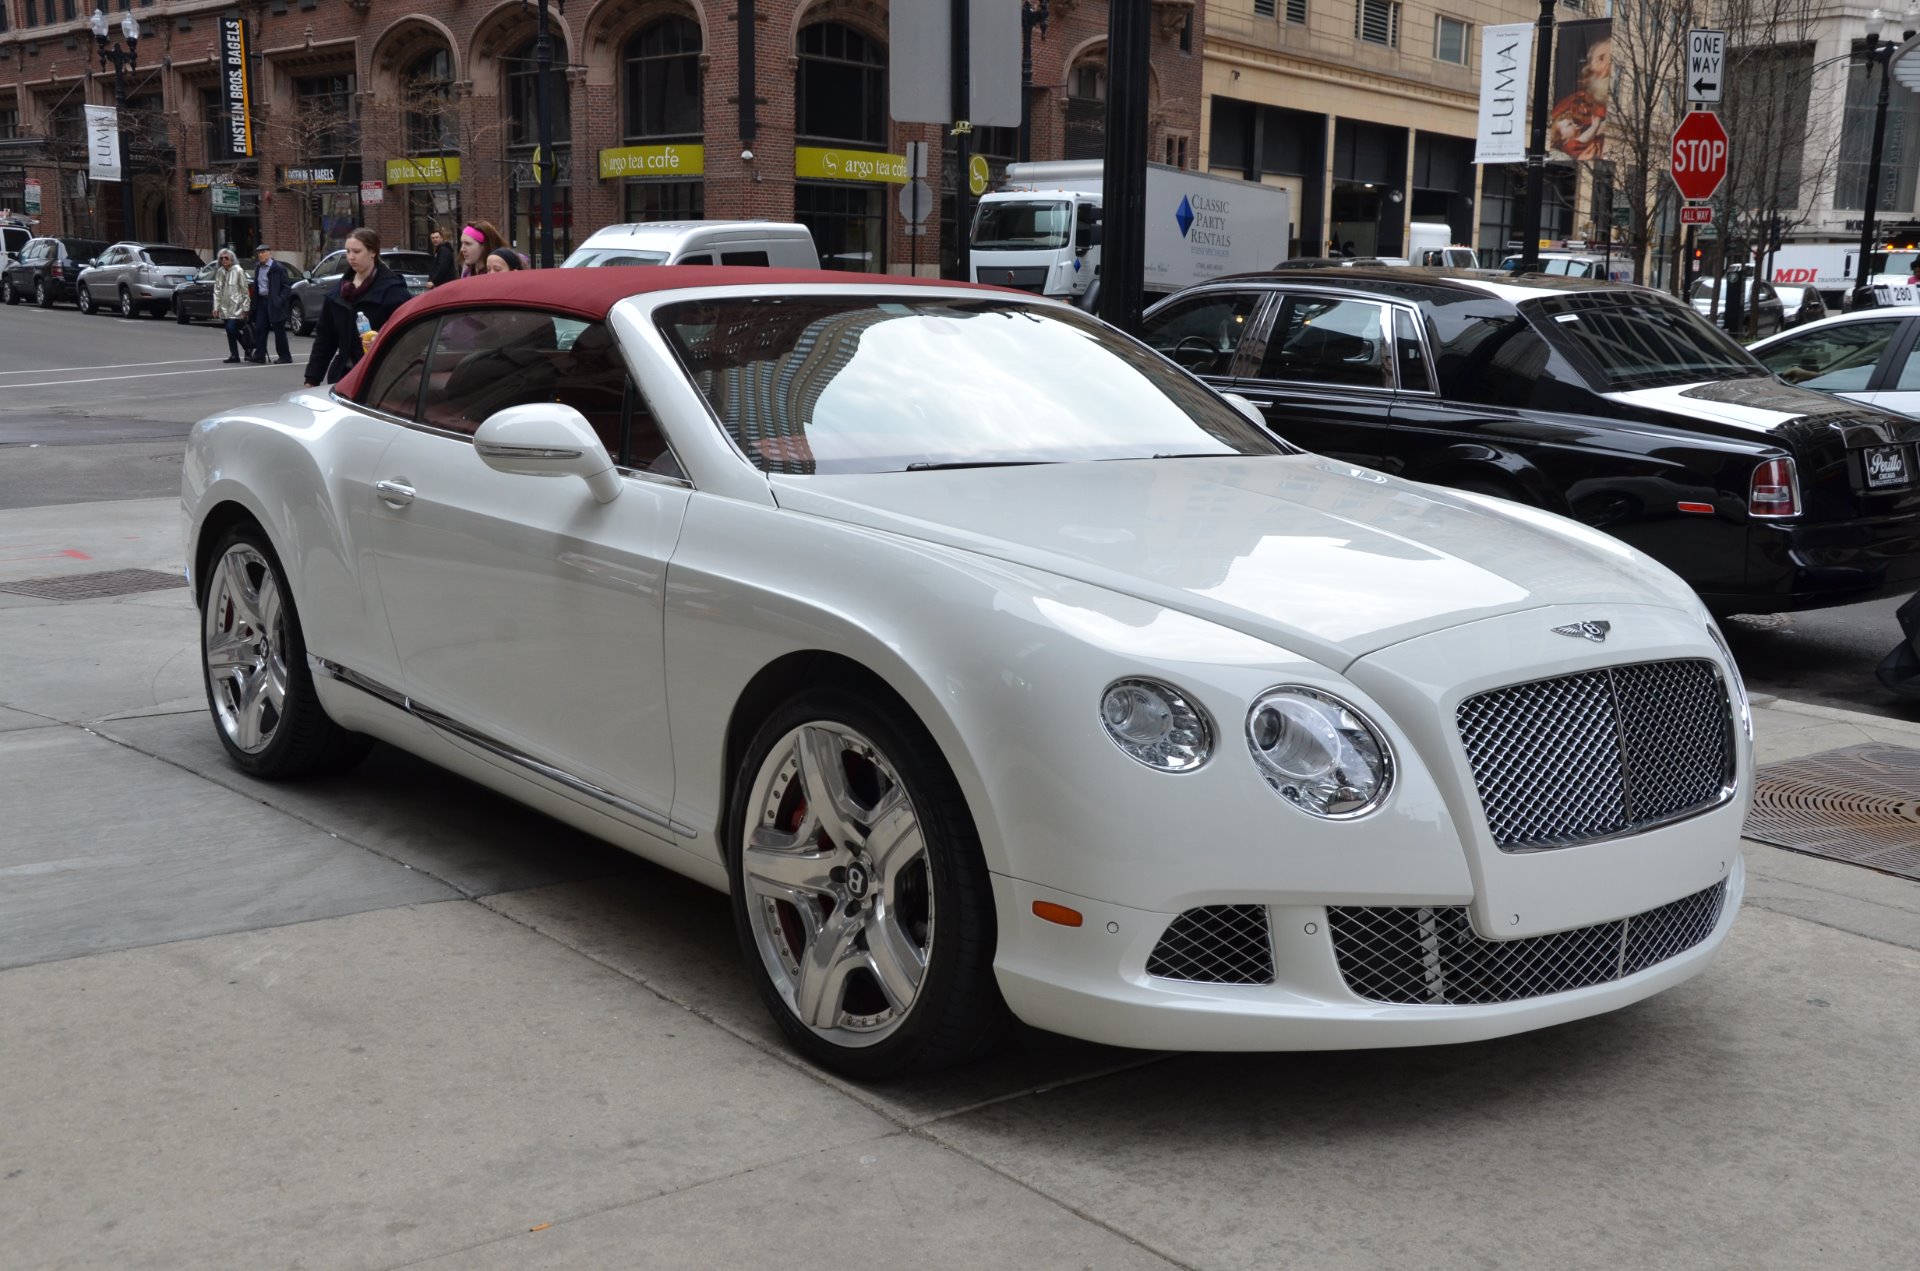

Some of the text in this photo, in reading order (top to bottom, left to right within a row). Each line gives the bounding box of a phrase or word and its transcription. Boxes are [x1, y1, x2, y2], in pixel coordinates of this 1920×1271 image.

[1693, 37, 1721, 54] ONE
[1692, 57, 1720, 74] WAY
[226, 21, 247, 153] EINSTEIN BROS. BAGELS
[1491, 42, 1519, 135] LUMA
[97, 116, 113, 167] LUMA
[609, 146, 679, 175] argo tea café
[1674, 138, 1724, 172] STOP
[314, 168, 334, 181] BAGELS
[417, 159, 442, 177] café
[845, 160, 873, 177] argo
[875, 160, 890, 175] tea
[1191, 194, 1230, 214] CLASSIC
[1196, 212, 1226, 231] PARTY
[1683, 211, 1709, 220] ALL WAY
[1191, 229, 1231, 248] RENTALS
[1774, 268, 1818, 282] MDI
[1894, 287, 1912, 301] 280
